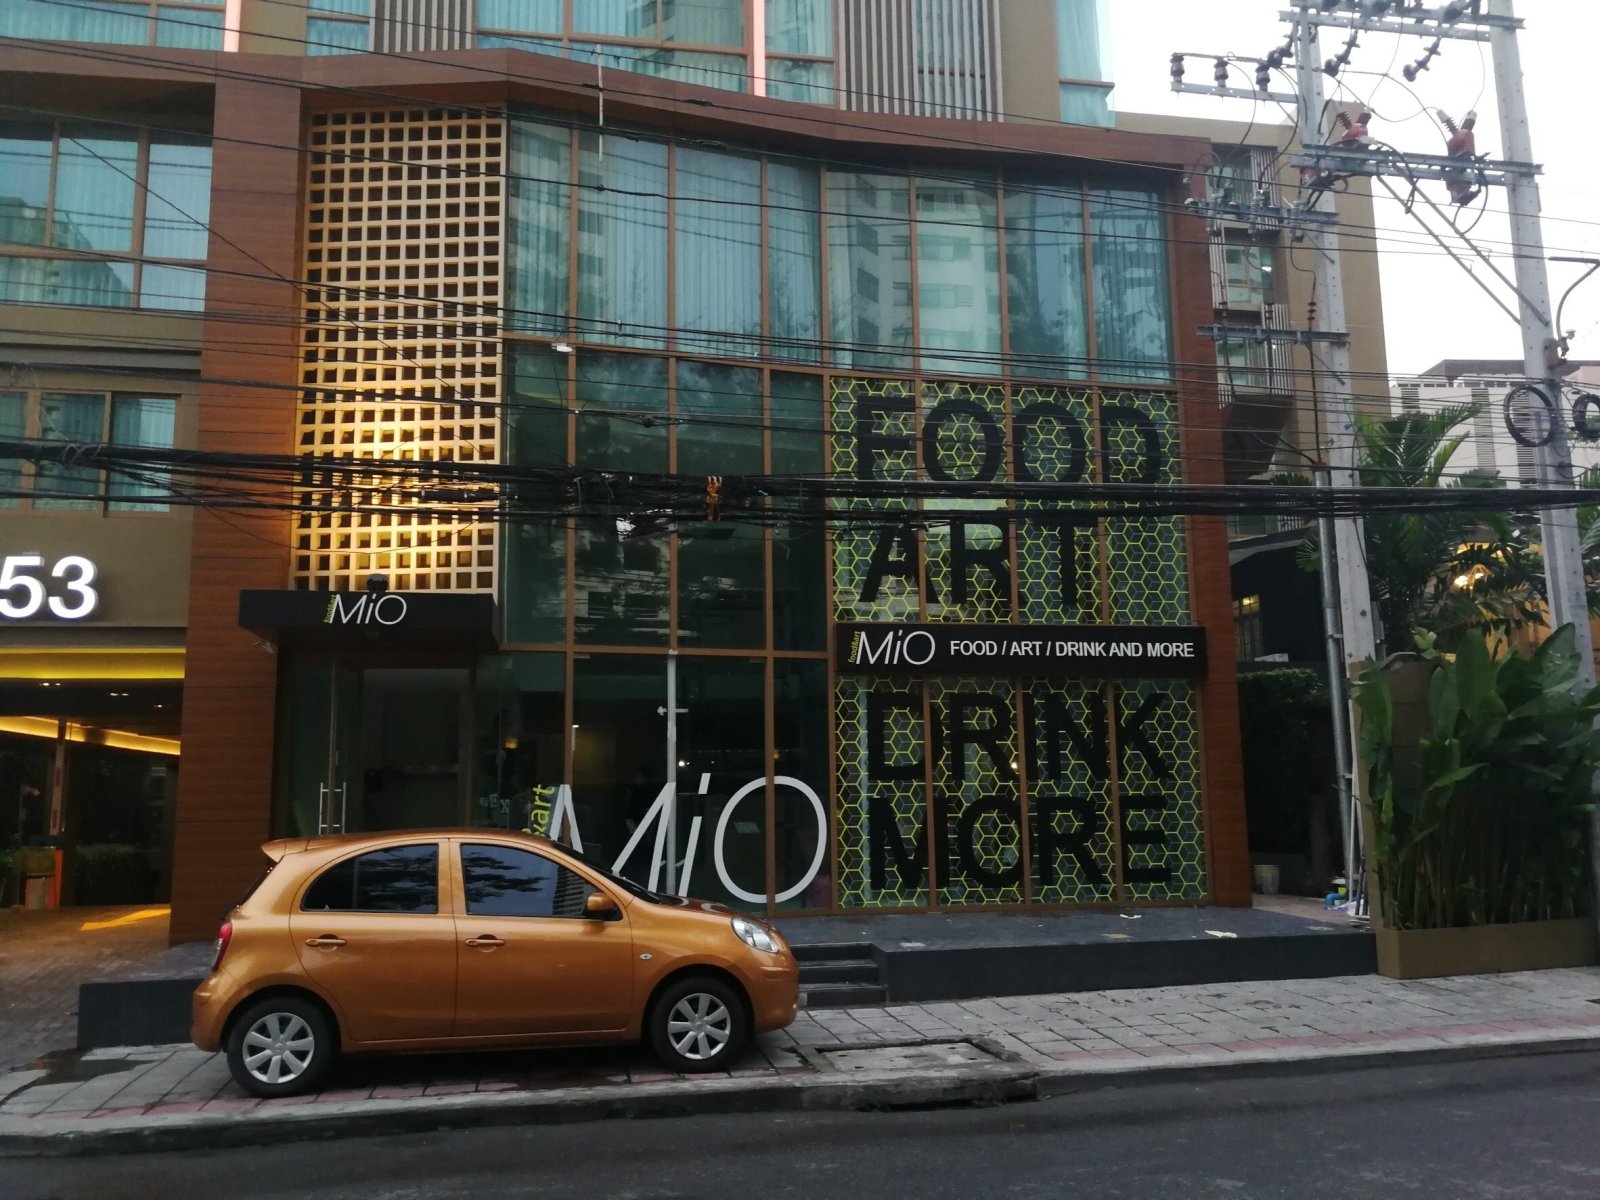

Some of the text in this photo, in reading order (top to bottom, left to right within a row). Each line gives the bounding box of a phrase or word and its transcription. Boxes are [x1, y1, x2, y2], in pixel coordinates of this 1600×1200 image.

[857, 396, 1161, 486] FOOD
[0, 555, 99, 619] 53
[859, 516, 1098, 606] ART
[950, 640, 998, 656] FOOD
[1009, 641, 1043, 656] ART
[1055, 641, 1107, 657] DRINK
[1109, 642, 1143, 657] AND
[1147, 642, 1195, 657] MORE
[868, 692, 1170, 782] DRINK
[869, 795, 1172, 890] MORE
